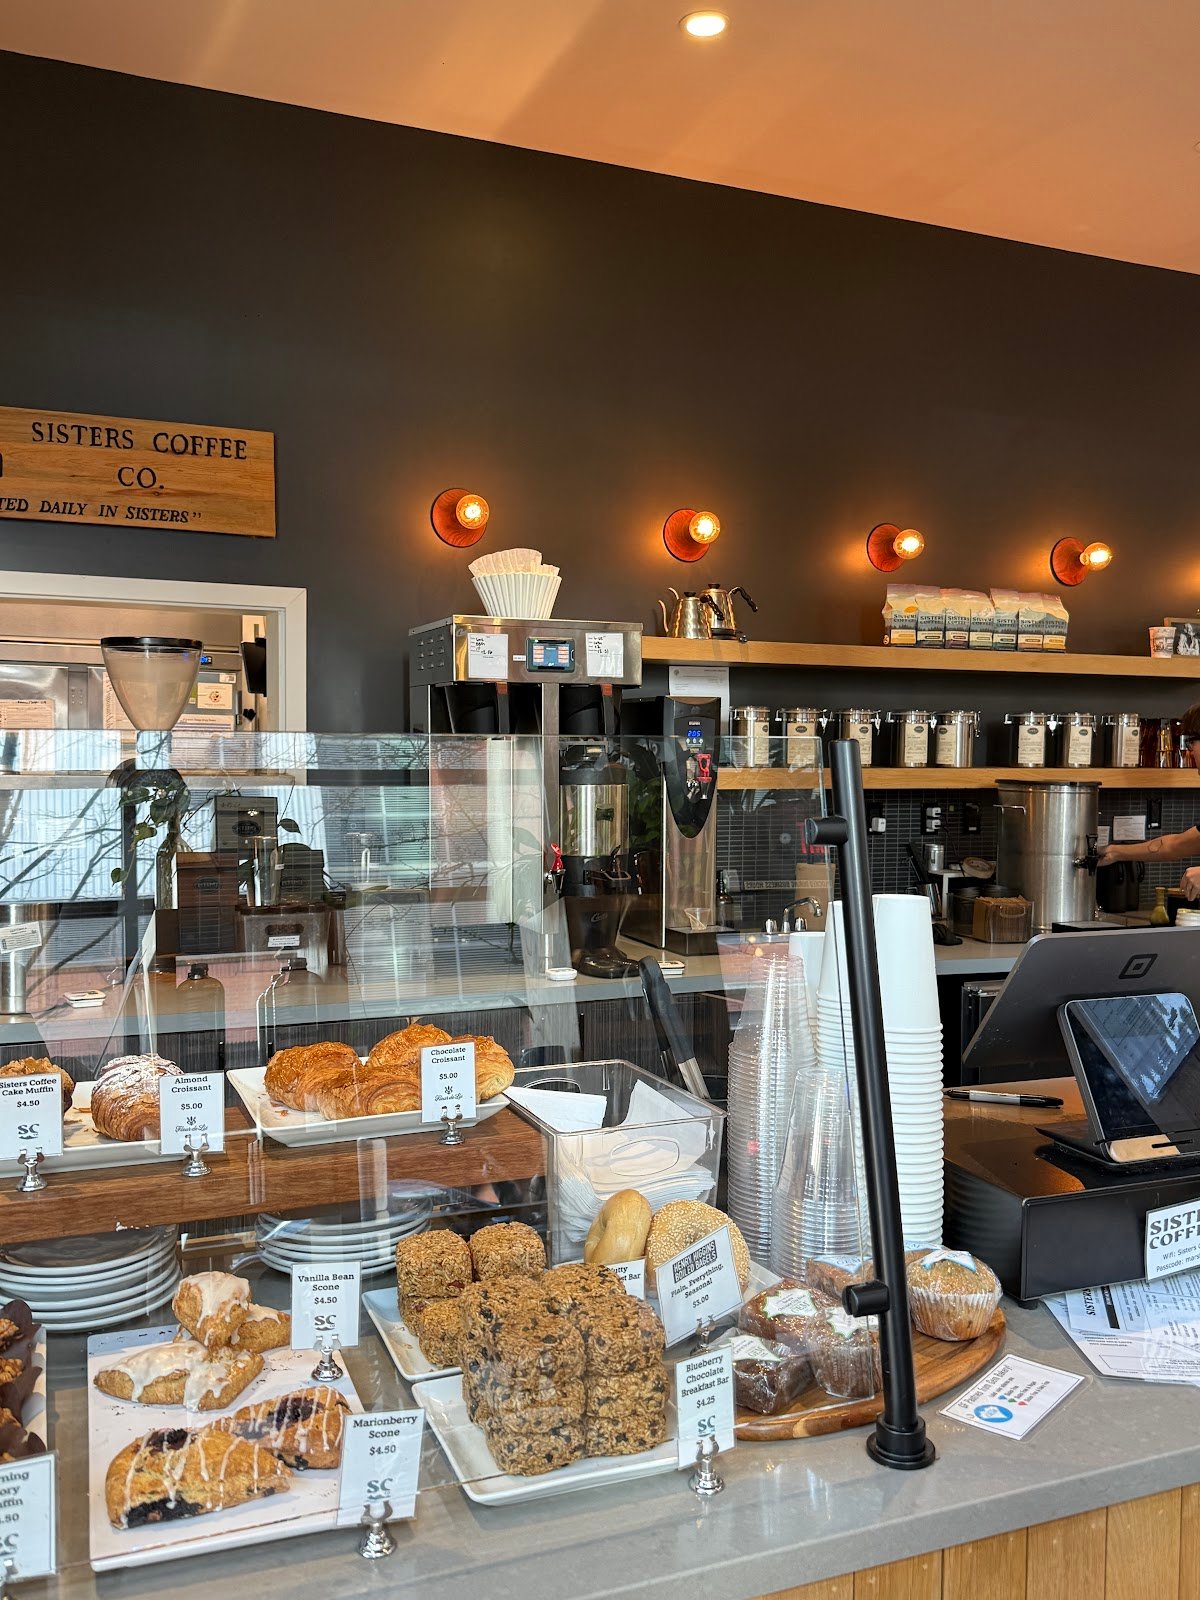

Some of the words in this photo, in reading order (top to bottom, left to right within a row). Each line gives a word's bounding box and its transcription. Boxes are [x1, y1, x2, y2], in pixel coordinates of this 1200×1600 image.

[32, 422, 134, 449] SISTERS
[153, 432, 247, 459] COFFEE
[117, 466, 164, 489] CO.
[39, 500, 88, 515] DAILY
[98, 504, 118, 517] IN
[431, 1047, 466, 1056] Chocolate
[432, 1055, 465, 1064] Croissant
[175, 1076, 207, 1084] Almond
[439, 1072, 458, 1080] $5.00
[26, 1086, 53, 1094] Muffin
[172, 1085, 211, 1093] Croissant
[18, 1124, 39, 1134] SC
[1178, 1245, 1196, 1256] Sisters
[674, 1256, 692, 1272] HENRY
[693, 1241, 715, 1260] HIGGINS
[695, 1251, 717, 1270] BAGELS
[312, 1284, 340, 1292] Scone
[684, 1277, 712, 1298] Seasonal
[314, 1296, 338, 1304] $4.50
[314, 1315, 336, 1326] SC
[686, 1355, 724, 1373] Blueberry
[686, 1366, 724, 1384] Chocolate
[681, 1380, 715, 1397] Breakfast
[717, 1376, 729, 1385] Bar
[696, 1395, 715, 1409] $4.25
[353, 1416, 418, 1428] Marionberry
[698, 1415, 715, 1433] SC
[369, 1429, 400, 1438] Scone
[369, 1445, 396, 1456] $4.50
[367, 1478, 393, 1493] SC
[0, 1513, 19, 1524] .50
